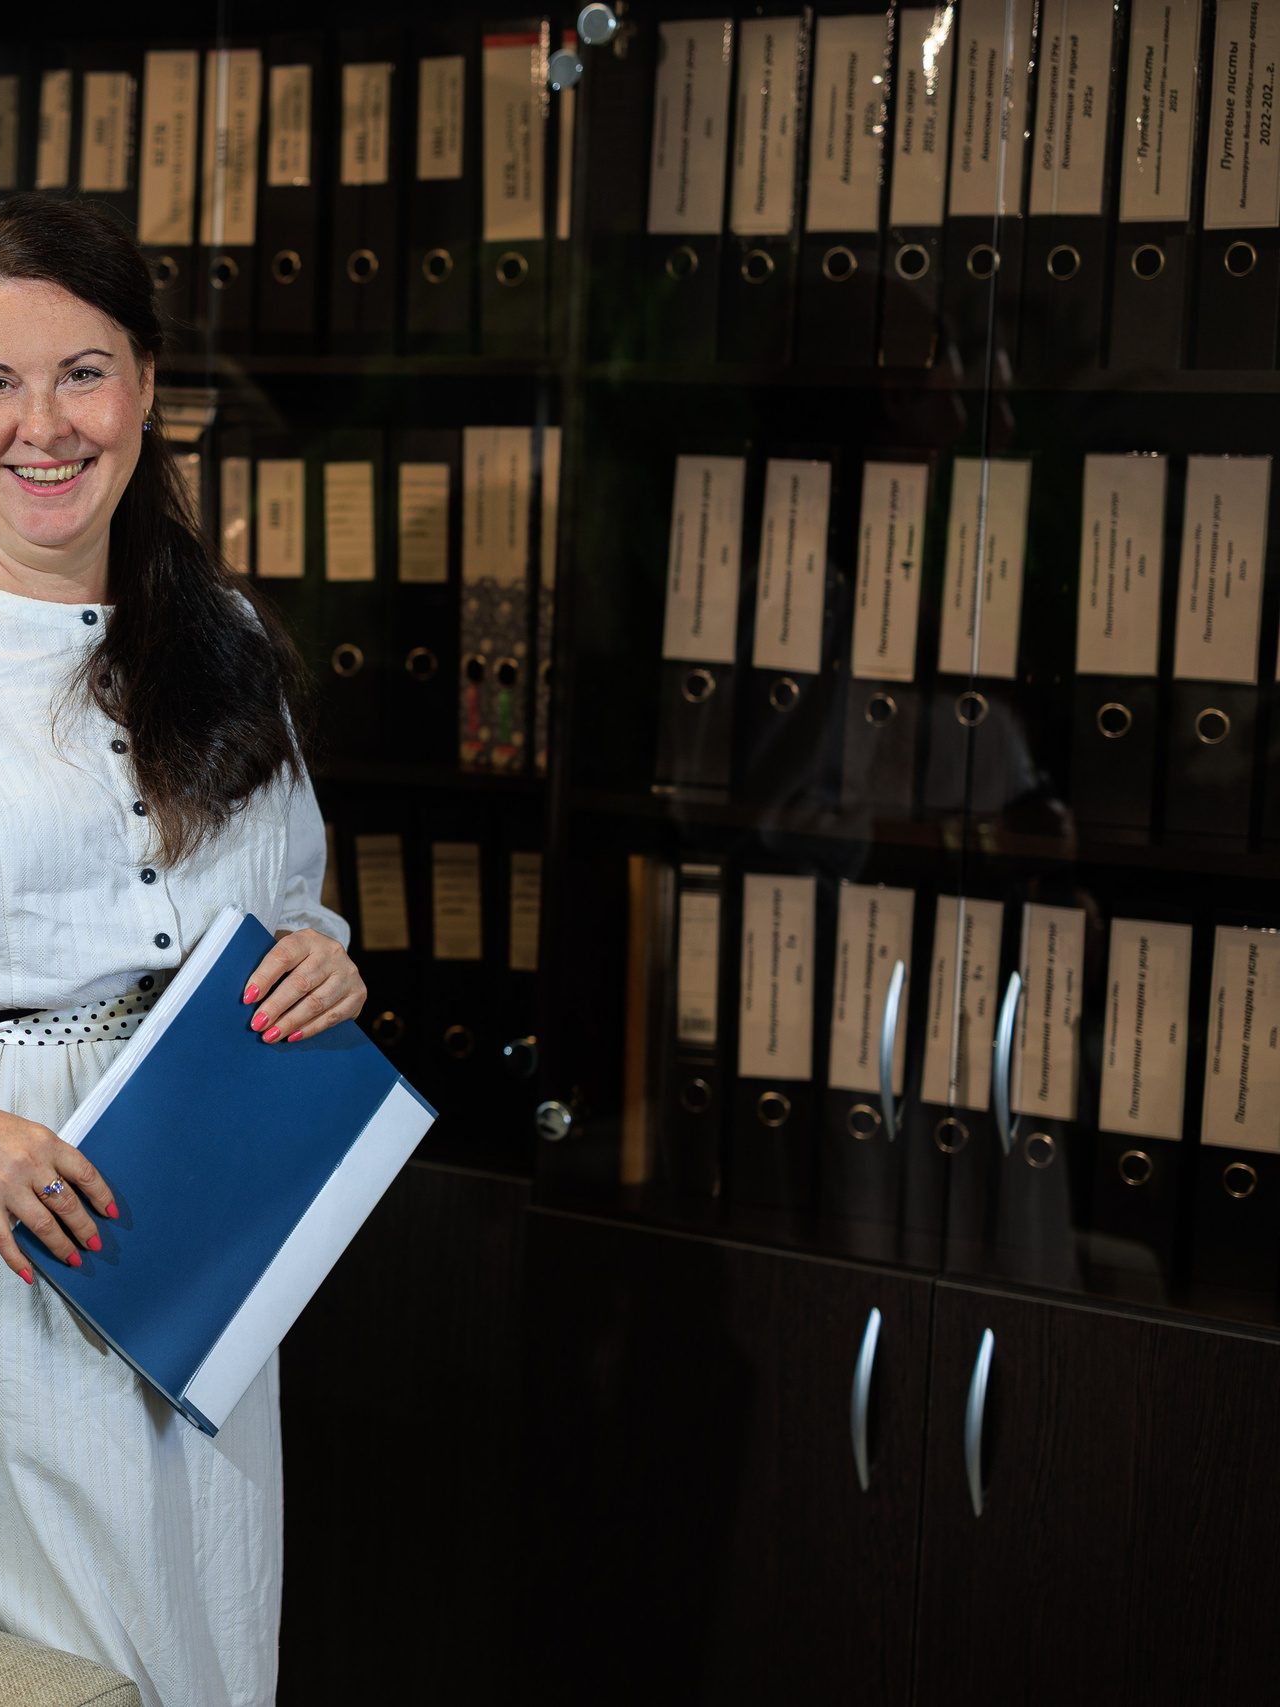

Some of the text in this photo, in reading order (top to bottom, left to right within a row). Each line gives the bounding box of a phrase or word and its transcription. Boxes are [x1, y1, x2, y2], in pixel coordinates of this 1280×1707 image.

[1042, 143, 1053, 171] ООО
[1136, 46, 1154, 158] Путевые листы
[1220, 41, 1239, 170] Путевые листы
